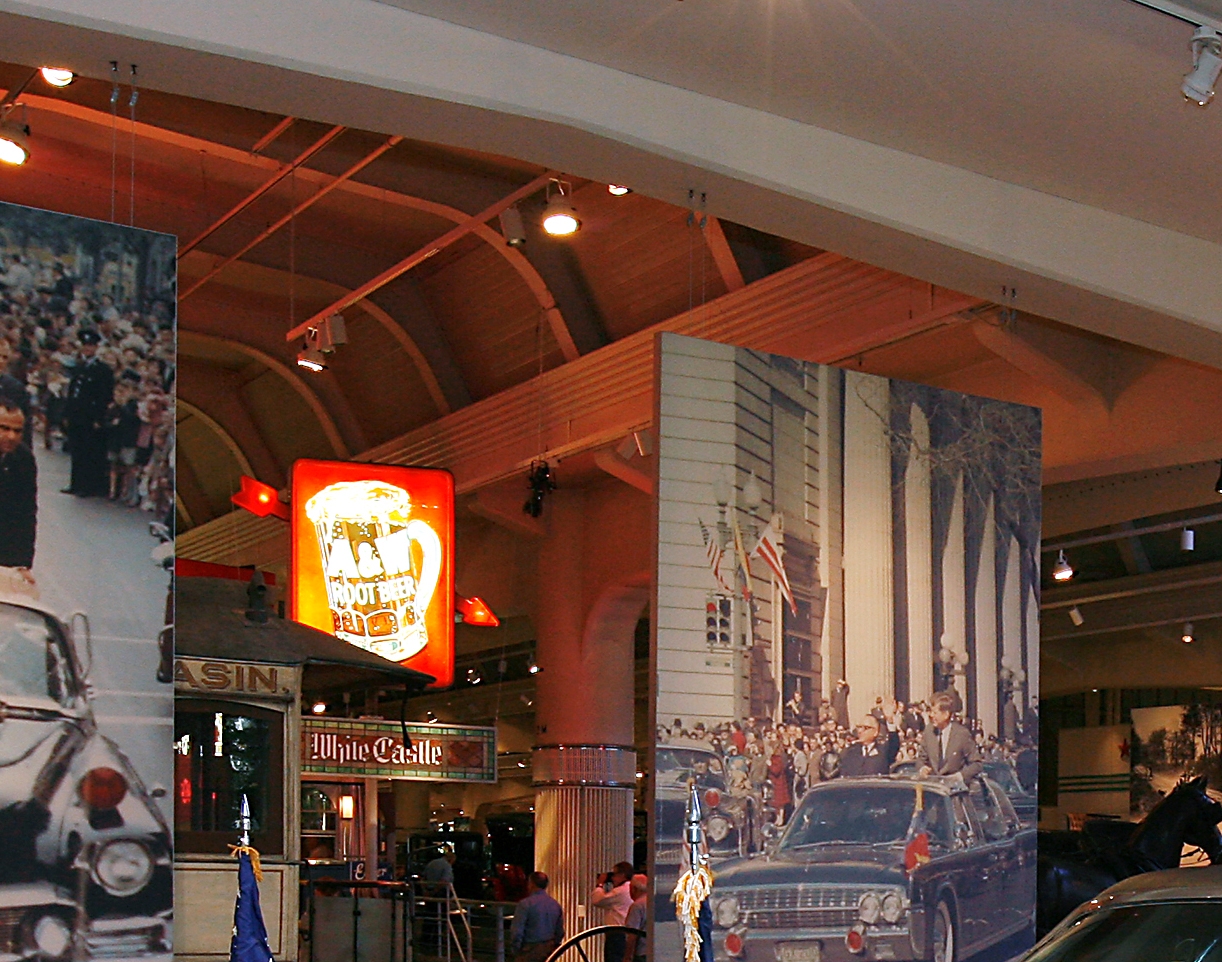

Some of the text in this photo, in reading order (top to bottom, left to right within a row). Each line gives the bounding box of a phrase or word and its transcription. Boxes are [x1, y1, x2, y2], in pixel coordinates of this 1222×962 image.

[331, 575, 416, 606] ROOT BEER
[311, 733, 444, 765] White Castle
